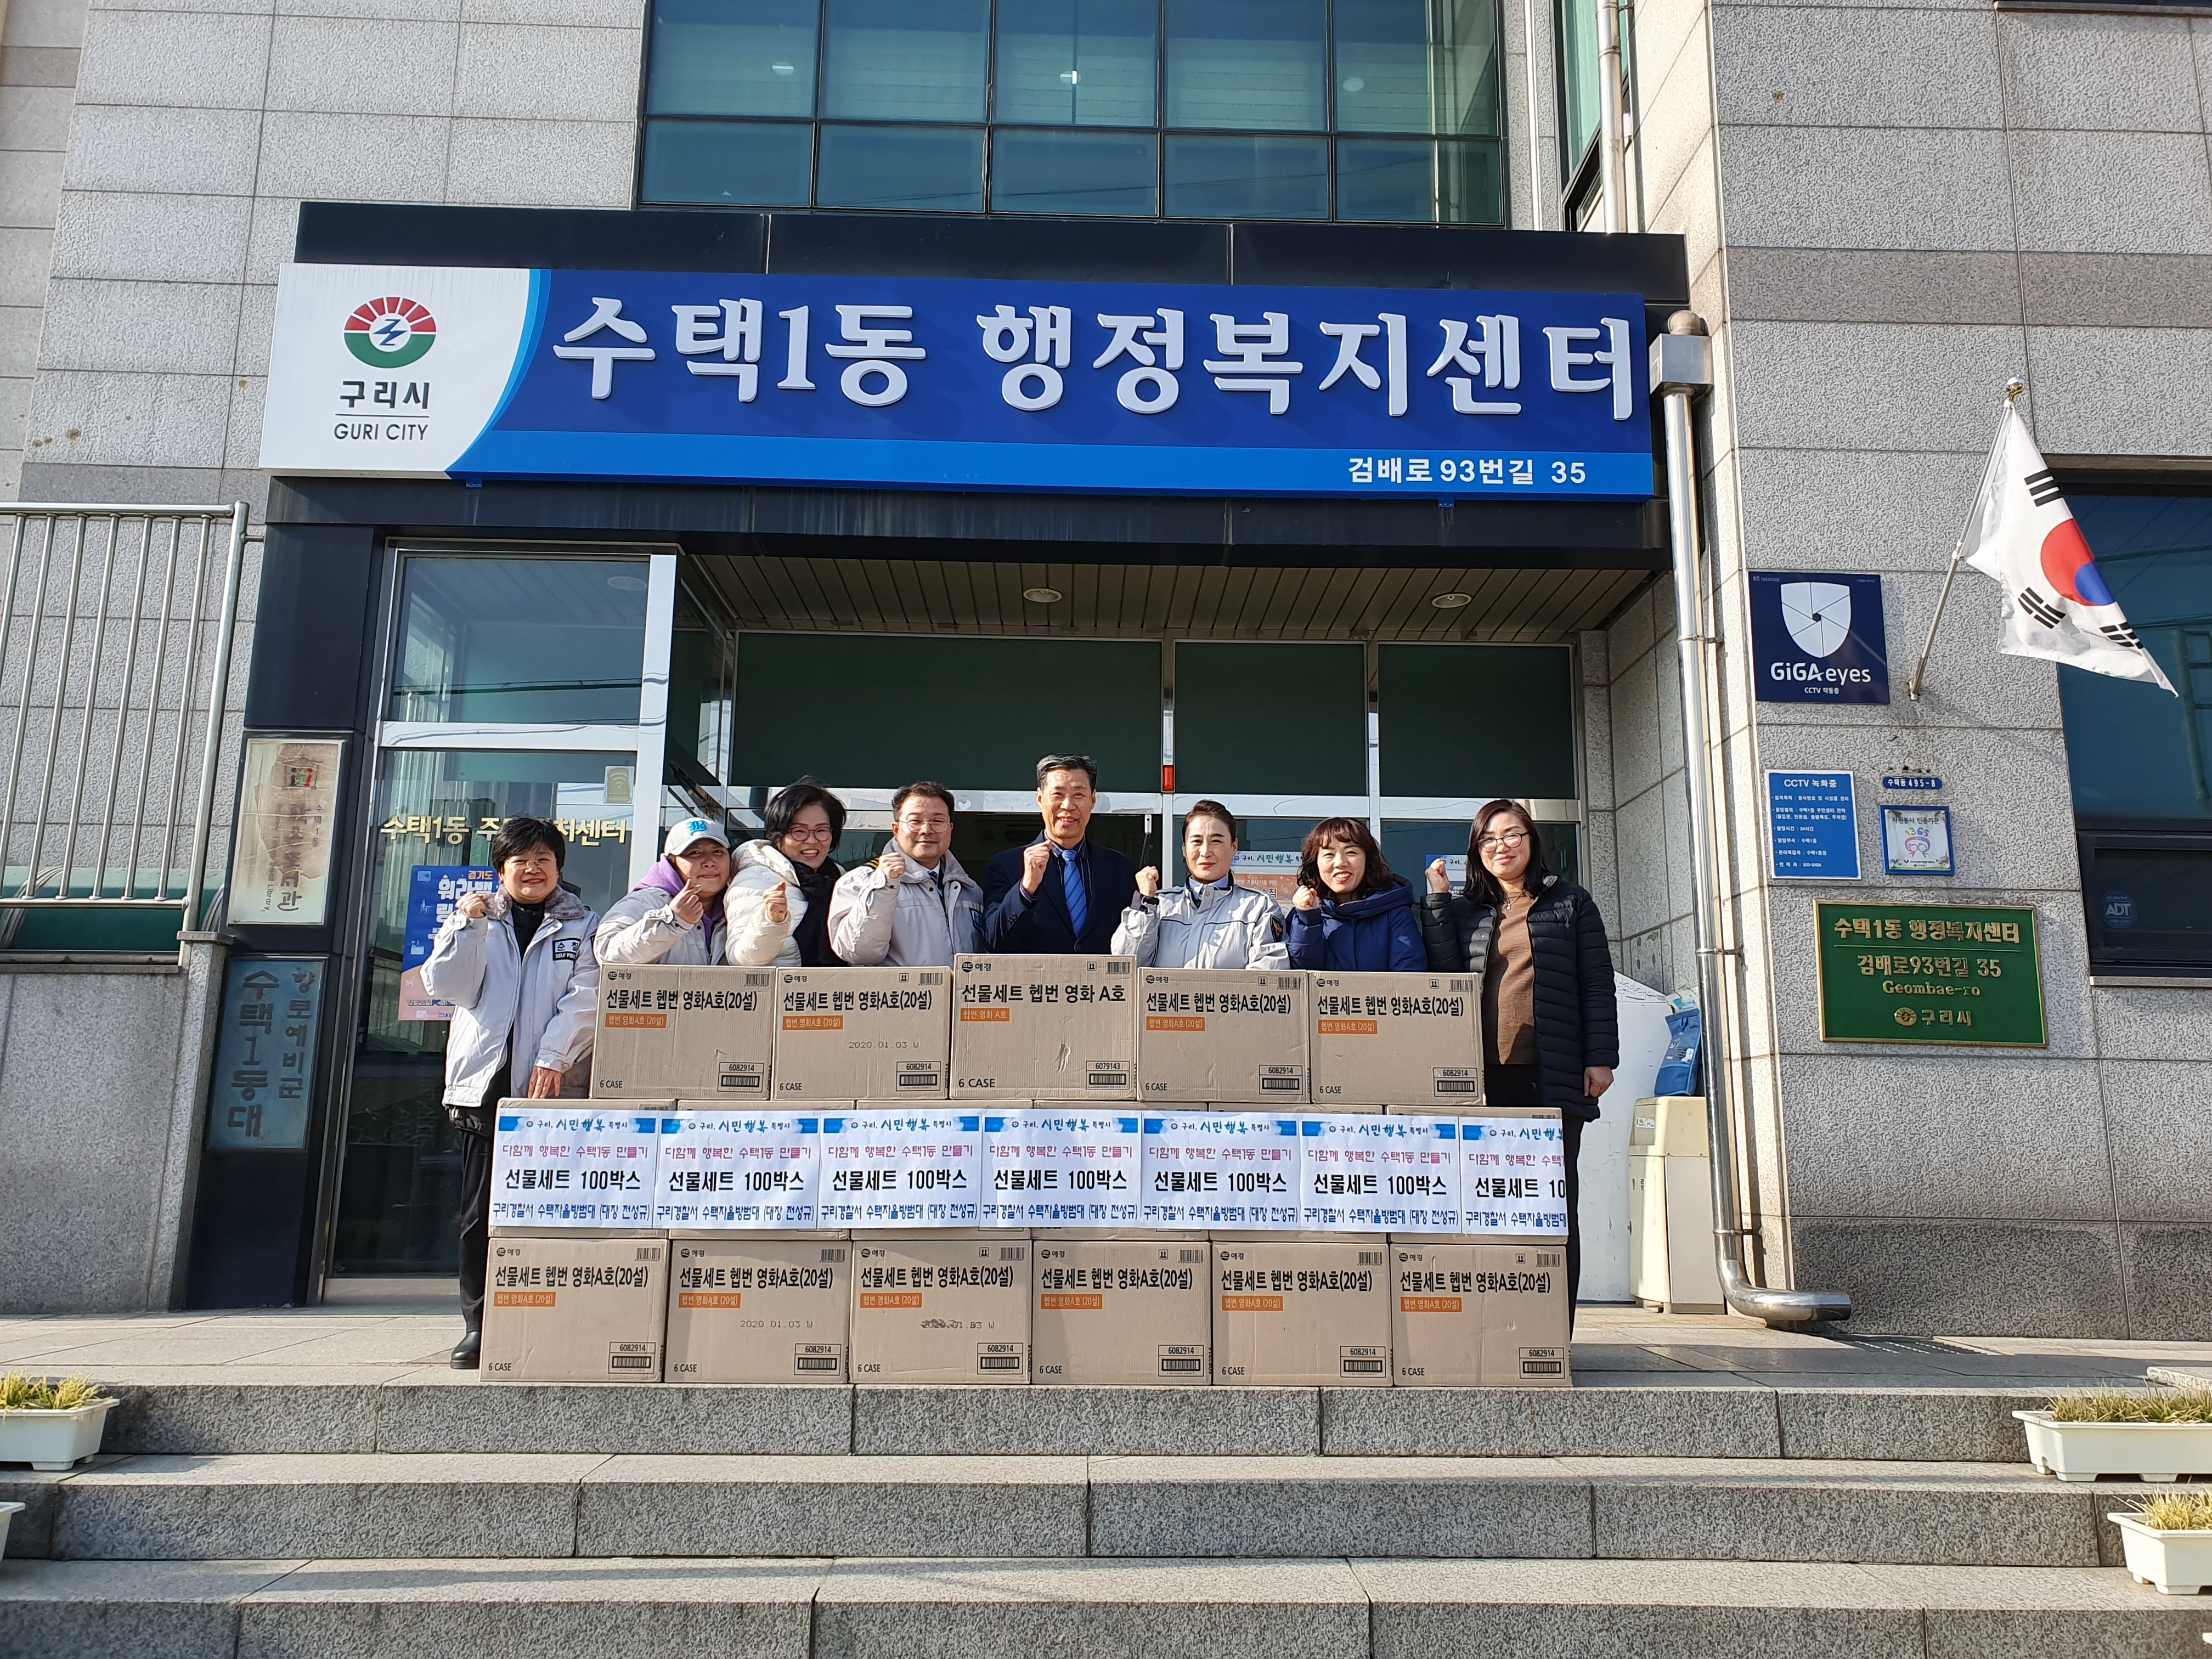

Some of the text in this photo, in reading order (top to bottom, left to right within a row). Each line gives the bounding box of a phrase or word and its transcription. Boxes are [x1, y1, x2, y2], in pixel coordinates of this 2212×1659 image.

[552, 296, 1634, 421] 수택1동 행정복지센터
[340, 381, 429, 409] 구리시
[334, 423, 428, 440] GURI CITY
[1551, 461, 1585, 483] 35
[1784, 779, 1837, 788] CCTV 녹화중
[1908, 779, 1936, 787] 495-8
[380, 815, 627, 847] 수택1동 주치센터
[1905, 827, 1930, 837] 1365
[1257, 854, 1294, 864] 시민행복
[468, 870, 494, 879] 경기도
[2105, 903, 2131, 916] ADT
[1834, 917, 2021, 944] 수택1동 행정복지센터
[975, 963, 991, 971] 애경
[1977, 958, 2002, 978] 35
[962, 984, 1125, 1003] 선물세트 헵번 영화 A호
[1882, 980, 1981, 997] Geombae-ro
[607, 989, 757, 1011] 선물세트 헵번 영화A호(20설)
[608, 1015, 621, 1026] 헵번
[963, 1009, 977, 1020] 헵번
[995, 1009, 1007, 1020] A호
[1921, 1009, 1972, 1027] 구리시
[227, 970, 279, 1137] 수택1동대
[606, 1080, 622, 1088] CASE
[959, 1078, 995, 1087] 6 CASE
[556, 1118, 605, 1132] 시민행복
[1042, 1118, 1089, 1132] 시민행복
[1093, 1121, 1110, 1129] 특별시
[503, 1144, 647, 1158] 다함께 행복한 수택1동 만들기
[990, 1145, 1132, 1158] 다함께 행복한 수택1동 만들기
[1469, 1153, 1499, 1165] 다함께
[1505, 1154, 1535, 1166] 행복한
[506, 1169, 640, 1190] 선물세트 100박스
[994, 1170, 1126, 1190] 선물세트 100박스
[1475, 1177, 1539, 1198] 선물세트
[493, 1203, 533, 1218] 구리경찰서
[538, 1203, 595, 1219] 수택자율방범대
[983, 1204, 1023, 1219] 구리경찰서
[1028, 1204, 1084, 1219] 수택자율방범대
[1466, 1211, 1506, 1226] 구리경찰서
[680, 1267, 833, 1289] 선물세트 헵번 영화A호(20설)
[1401, 1271, 1550, 1293] 선물세트 헵번 영화A호(20설)
[681, 1295, 695, 1306] 헵번
[1403, 1299, 1416, 1310] 헵번
[805, 1345, 832, 1353] 6082914
[1528, 1349, 1555, 1357] 6082914
[674, 1363, 697, 1372] 6 CASE
[1402, 1367, 1424, 1375] 6 CASE
